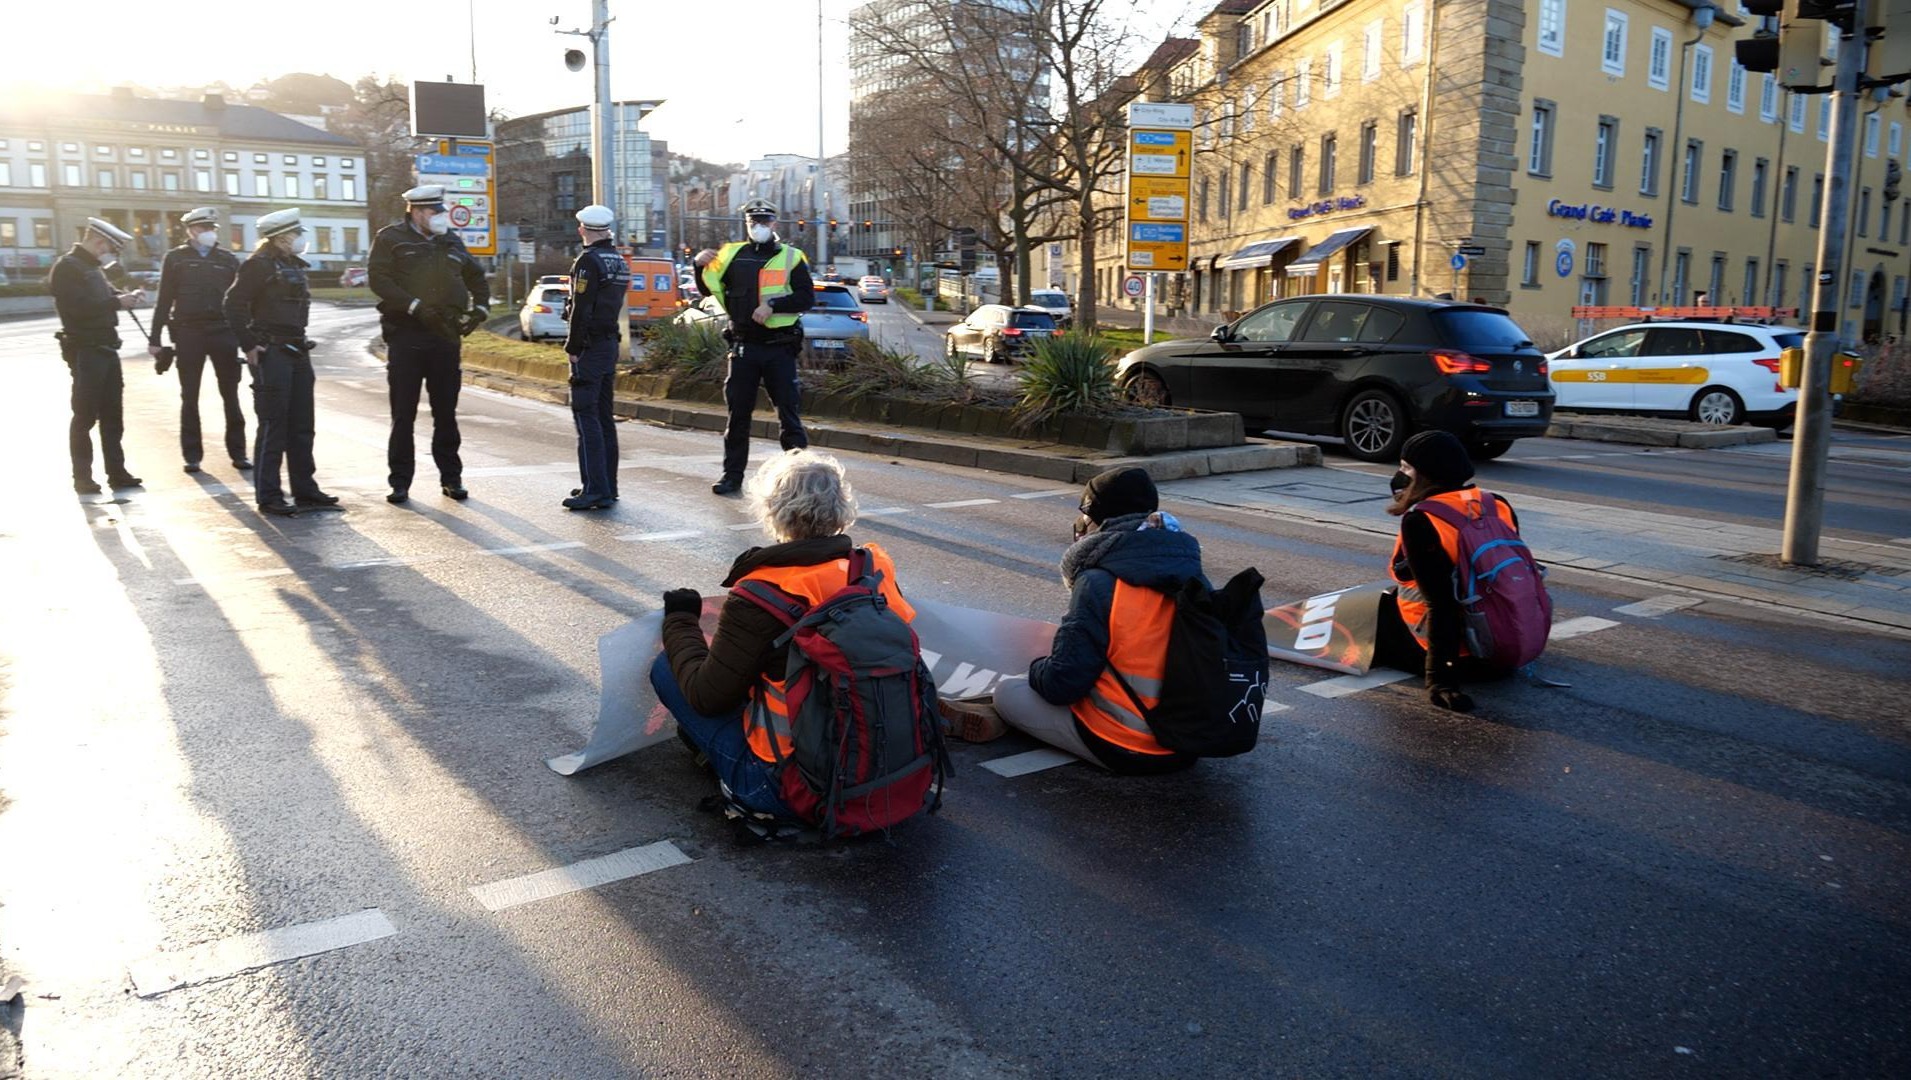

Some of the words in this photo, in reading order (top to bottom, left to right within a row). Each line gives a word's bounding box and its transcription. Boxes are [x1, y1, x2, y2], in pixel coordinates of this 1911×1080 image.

[421, 156, 432, 171] P
[1547, 198, 1588, 221] Grand
[1589, 204, 1617, 224] Café
[1127, 280, 1142, 292] 40
[1587, 371, 1607, 382] SSB
